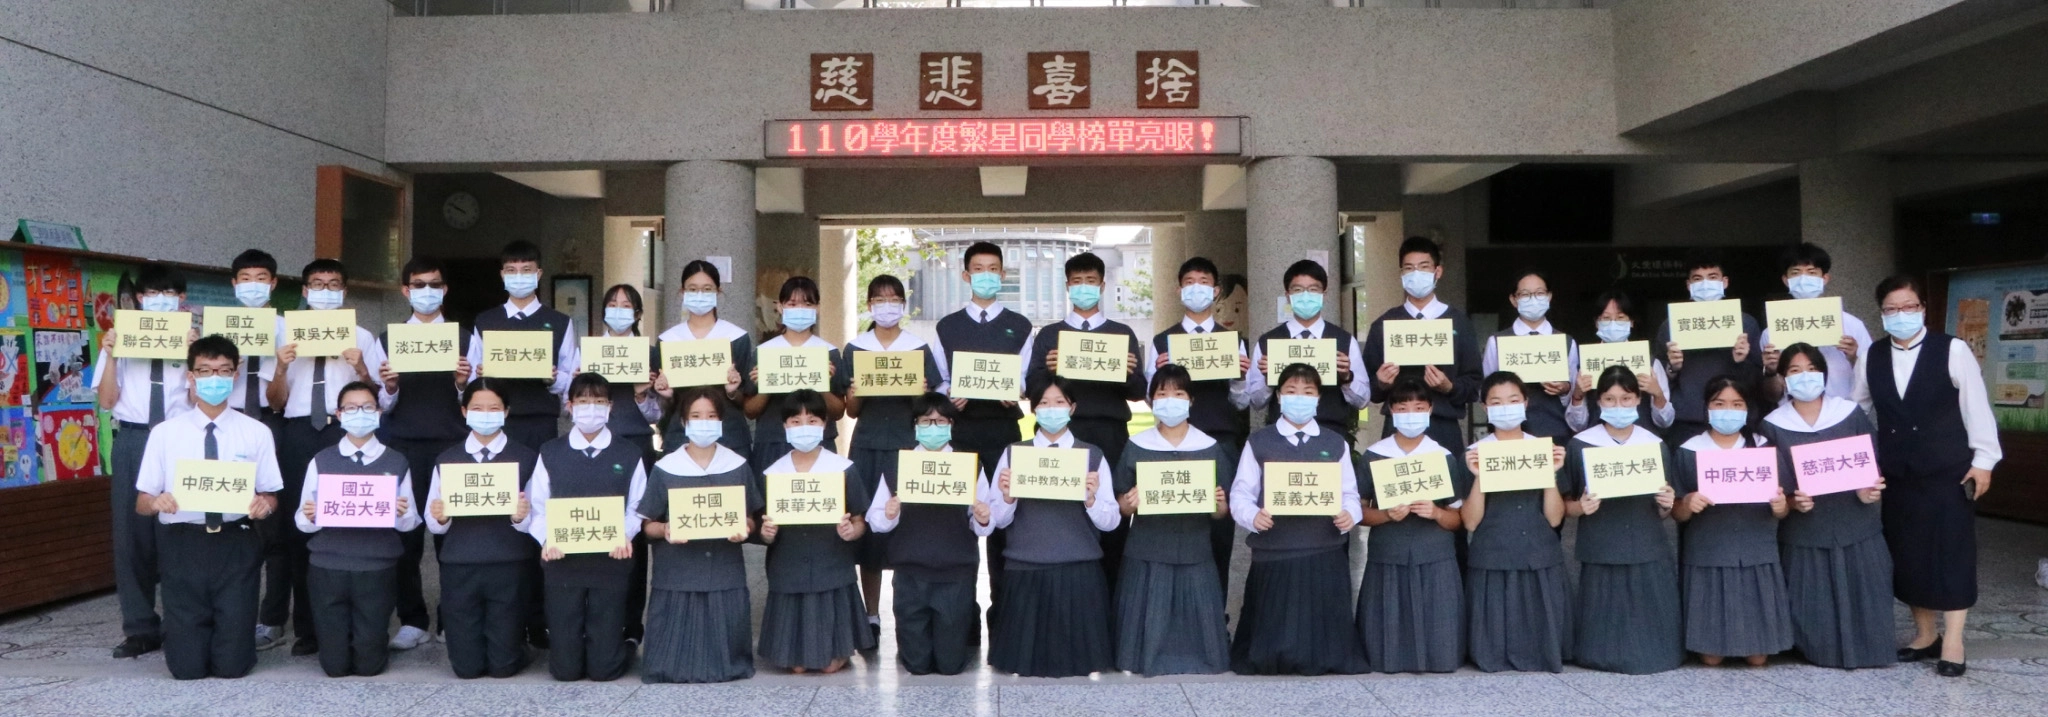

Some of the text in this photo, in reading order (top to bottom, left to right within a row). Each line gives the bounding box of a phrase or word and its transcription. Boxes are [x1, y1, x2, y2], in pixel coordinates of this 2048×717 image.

[814, 55, 1197, 106] 慈悲喜捨
[139, 316, 169, 331] 國立
[225, 315, 255, 329] 國立
[1677, 314, 1736, 332] 實踐大學
[1774, 314, 1836, 332] 銘傳大學
[122, 334, 183, 350] 聯合大學
[210, 331, 270, 347] 蘭大學
[292, 326, 350, 342] 東吳大學
[1389, 332, 1448, 348] 逢甲大學
[395, 339, 453, 355] 淡江大學
[601, 344, 629, 359] 國立
[1079, 338, 1108, 354] 國立
[1189, 336, 1219, 353] 國立
[1288, 344, 1316, 359] 國立
[490, 347, 547, 362] 元智大學
[669, 352, 726, 370] 實踐大學
[779, 354, 808, 369] 國立
[874, 355, 903, 370] 國立
[1175, 353, 1235, 371] 交通大學
[1505, 350, 1562, 367] 淡江大學
[587, 361, 644, 376] 中正大學
[973, 358, 1001, 373] 國立
[1064, 355, 1121, 372] 臺灣大學
[765, 371, 822, 387] 臺北大學
[860, 372, 918, 387] 清華大學
[957, 374, 1014, 391] 成功大學
[921, 460, 952, 476] 國立
[1038, 457, 1060, 469] 國立
[1393, 459, 1426, 478] 國立
[1485, 453, 1548, 472] 亞洲大學
[1591, 457, 1658, 479] 慈濟大學
[1801, 451, 1871, 476] 慈濟大學
[464, 472, 496, 488] 國立
[1016, 473, 1081, 488] 臺中教育大學
[1160, 469, 1192, 486] 高雄
[1288, 471, 1319, 487] 國立
[1704, 465, 1772, 484] 中原大學
[182, 475, 248, 494] 中原大學
[341, 480, 375, 497] 國立
[790, 478, 822, 494] 國立
[905, 478, 967, 497] 中山大學
[1383, 474, 1444, 498] 臺東大學
[448, 491, 512, 508] 中興大學
[692, 492, 723, 509] 中國
[1145, 488, 1207, 505] 醫學大學
[1272, 490, 1335, 507] 嘉義大學
[323, 500, 391, 517] 政治大學
[775, 497, 837, 514] 東華大學
[569, 506, 601, 523] 中山
[677, 511, 739, 530] 文化大學
[554, 525, 618, 543] 醫學大學
